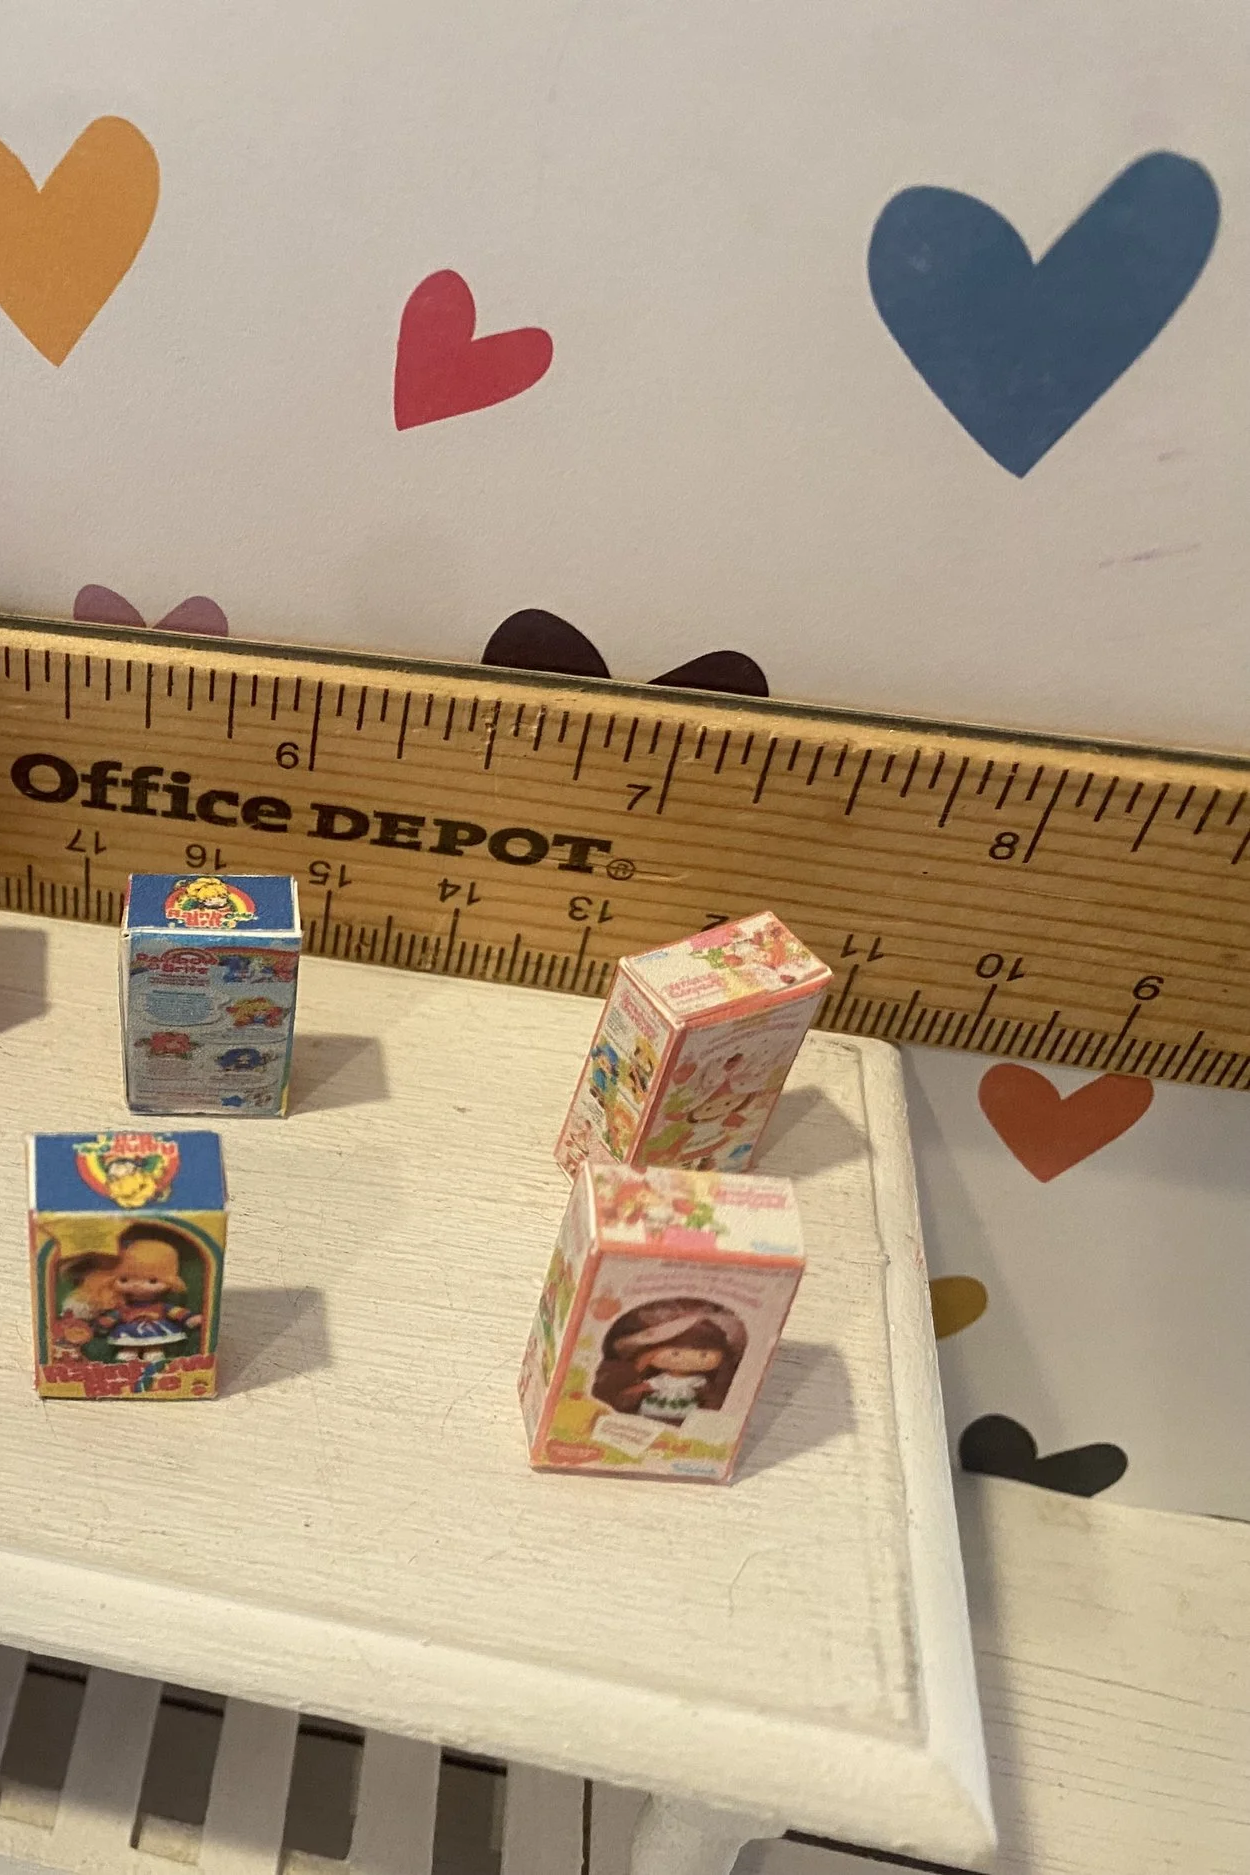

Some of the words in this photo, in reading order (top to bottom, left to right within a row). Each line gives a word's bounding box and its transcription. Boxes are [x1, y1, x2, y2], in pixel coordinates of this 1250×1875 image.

[276, 742, 299, 769] 6
[11, 753, 292, 833] Office
[626, 784, 652, 811] 7
[65, 829, 106, 855] 17
[989, 832, 1020, 860] 8
[185, 844, 227, 870] 16
[309, 861, 352, 888] 15
[438, 878, 481, 906] 14
[569, 896, 613, 924] 13
[841, 934, 884, 963] 11
[975, 953, 1025, 982] 10
